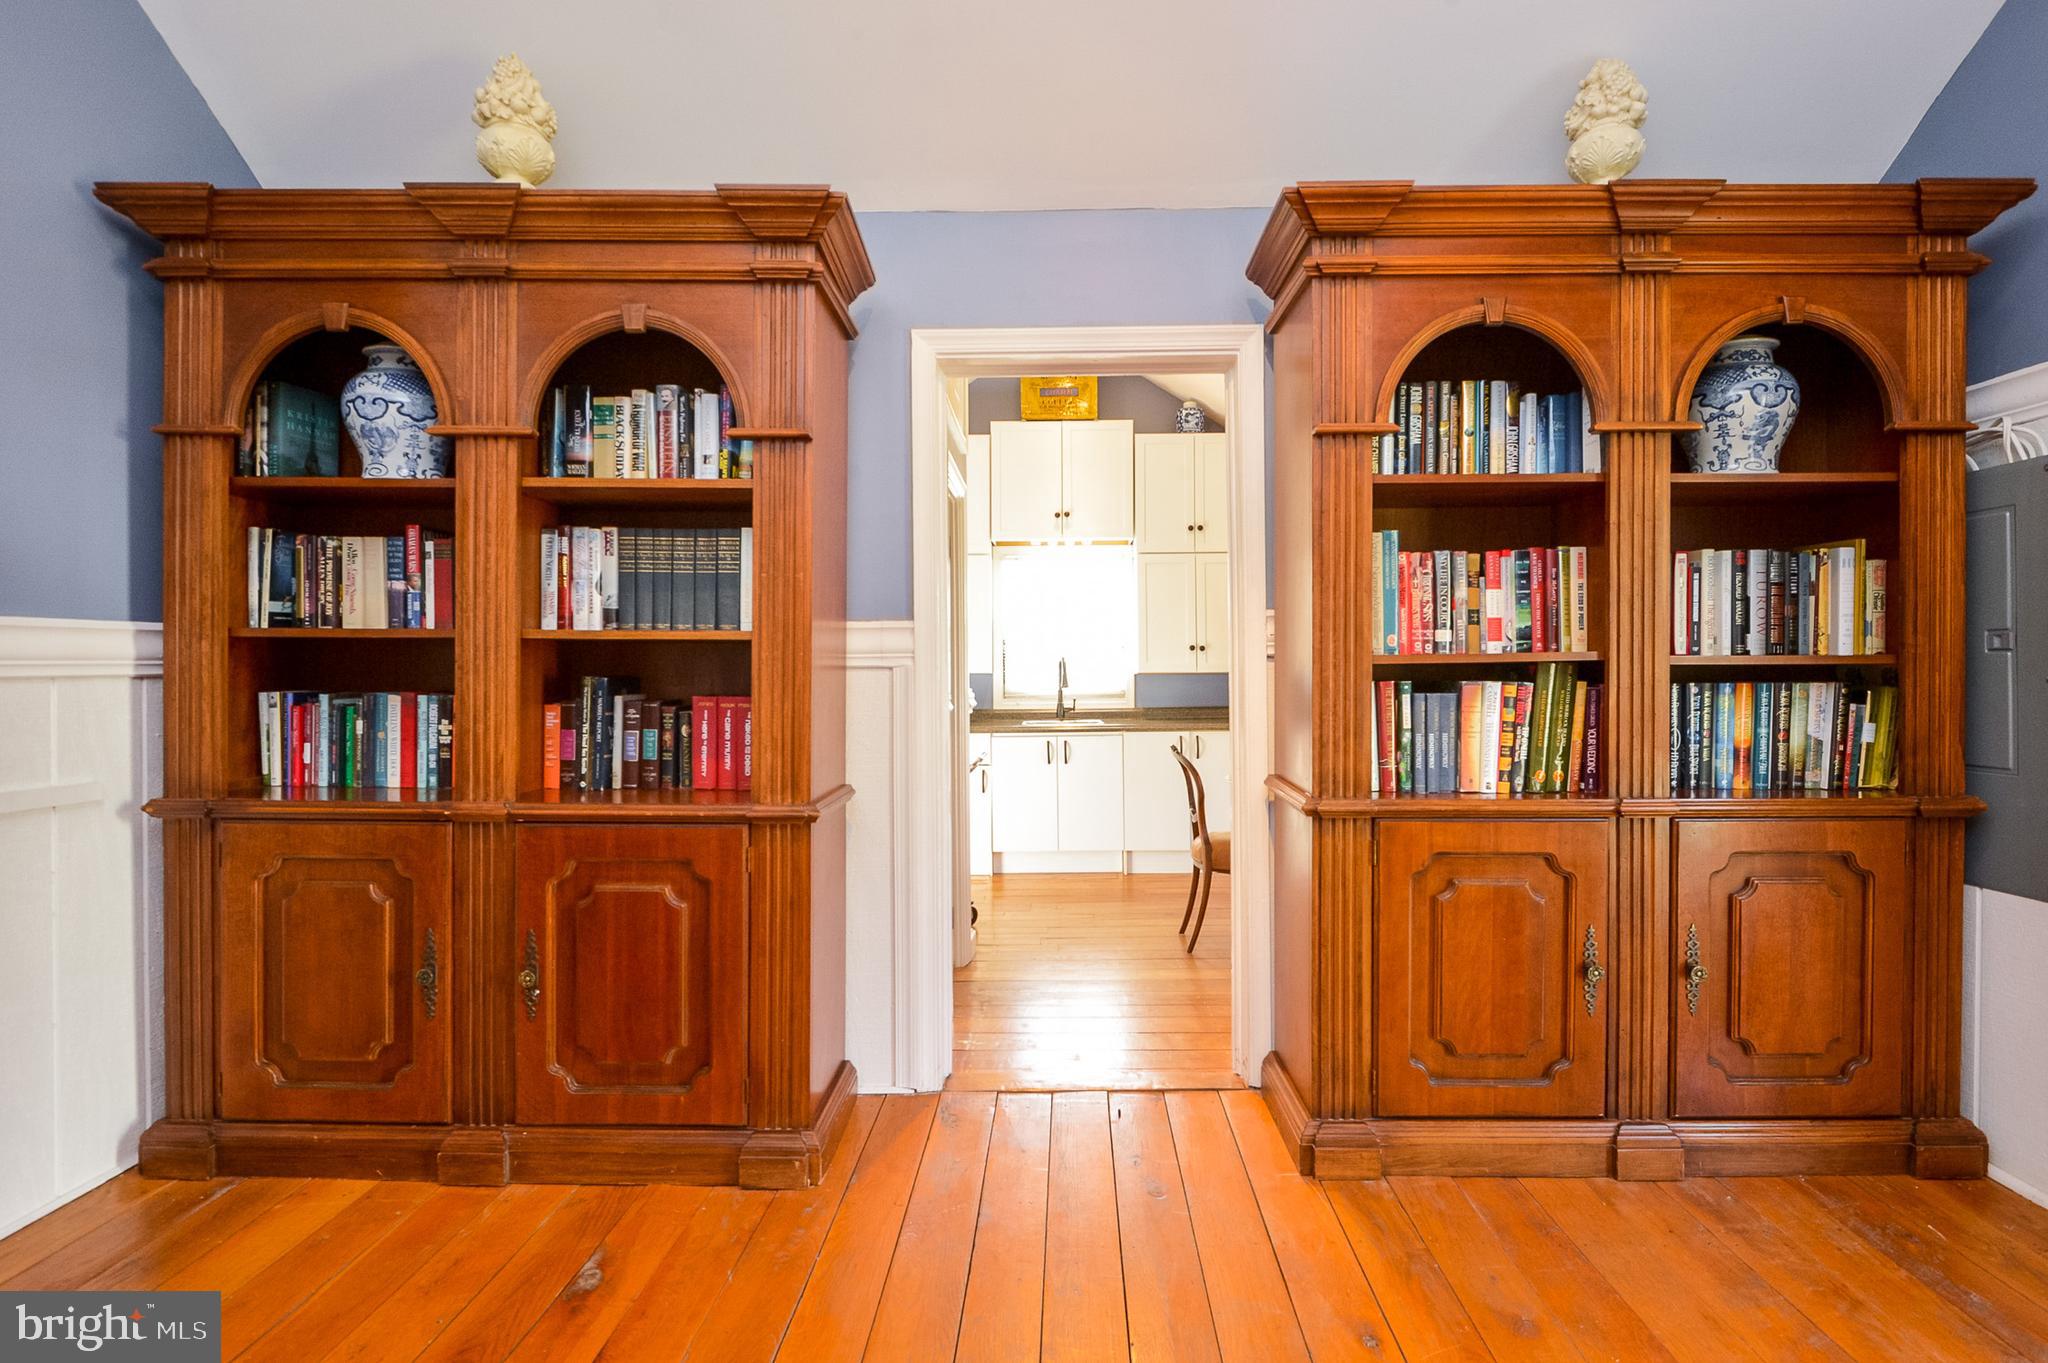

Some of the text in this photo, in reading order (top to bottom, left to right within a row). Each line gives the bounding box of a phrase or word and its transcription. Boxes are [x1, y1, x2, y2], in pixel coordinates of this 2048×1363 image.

[615, 405, 625, 438] BLACK
[1410, 386, 1423, 445] JOHN GRISHAM
[1506, 426, 1519, 474] JOHN GRISHAM
[1439, 596, 1448, 624] COURT
[1756, 571, 1767, 636] TUROW
[1587, 728, 1597, 746] YOUR
[1587, 746, 1596, 774] WEDDING
